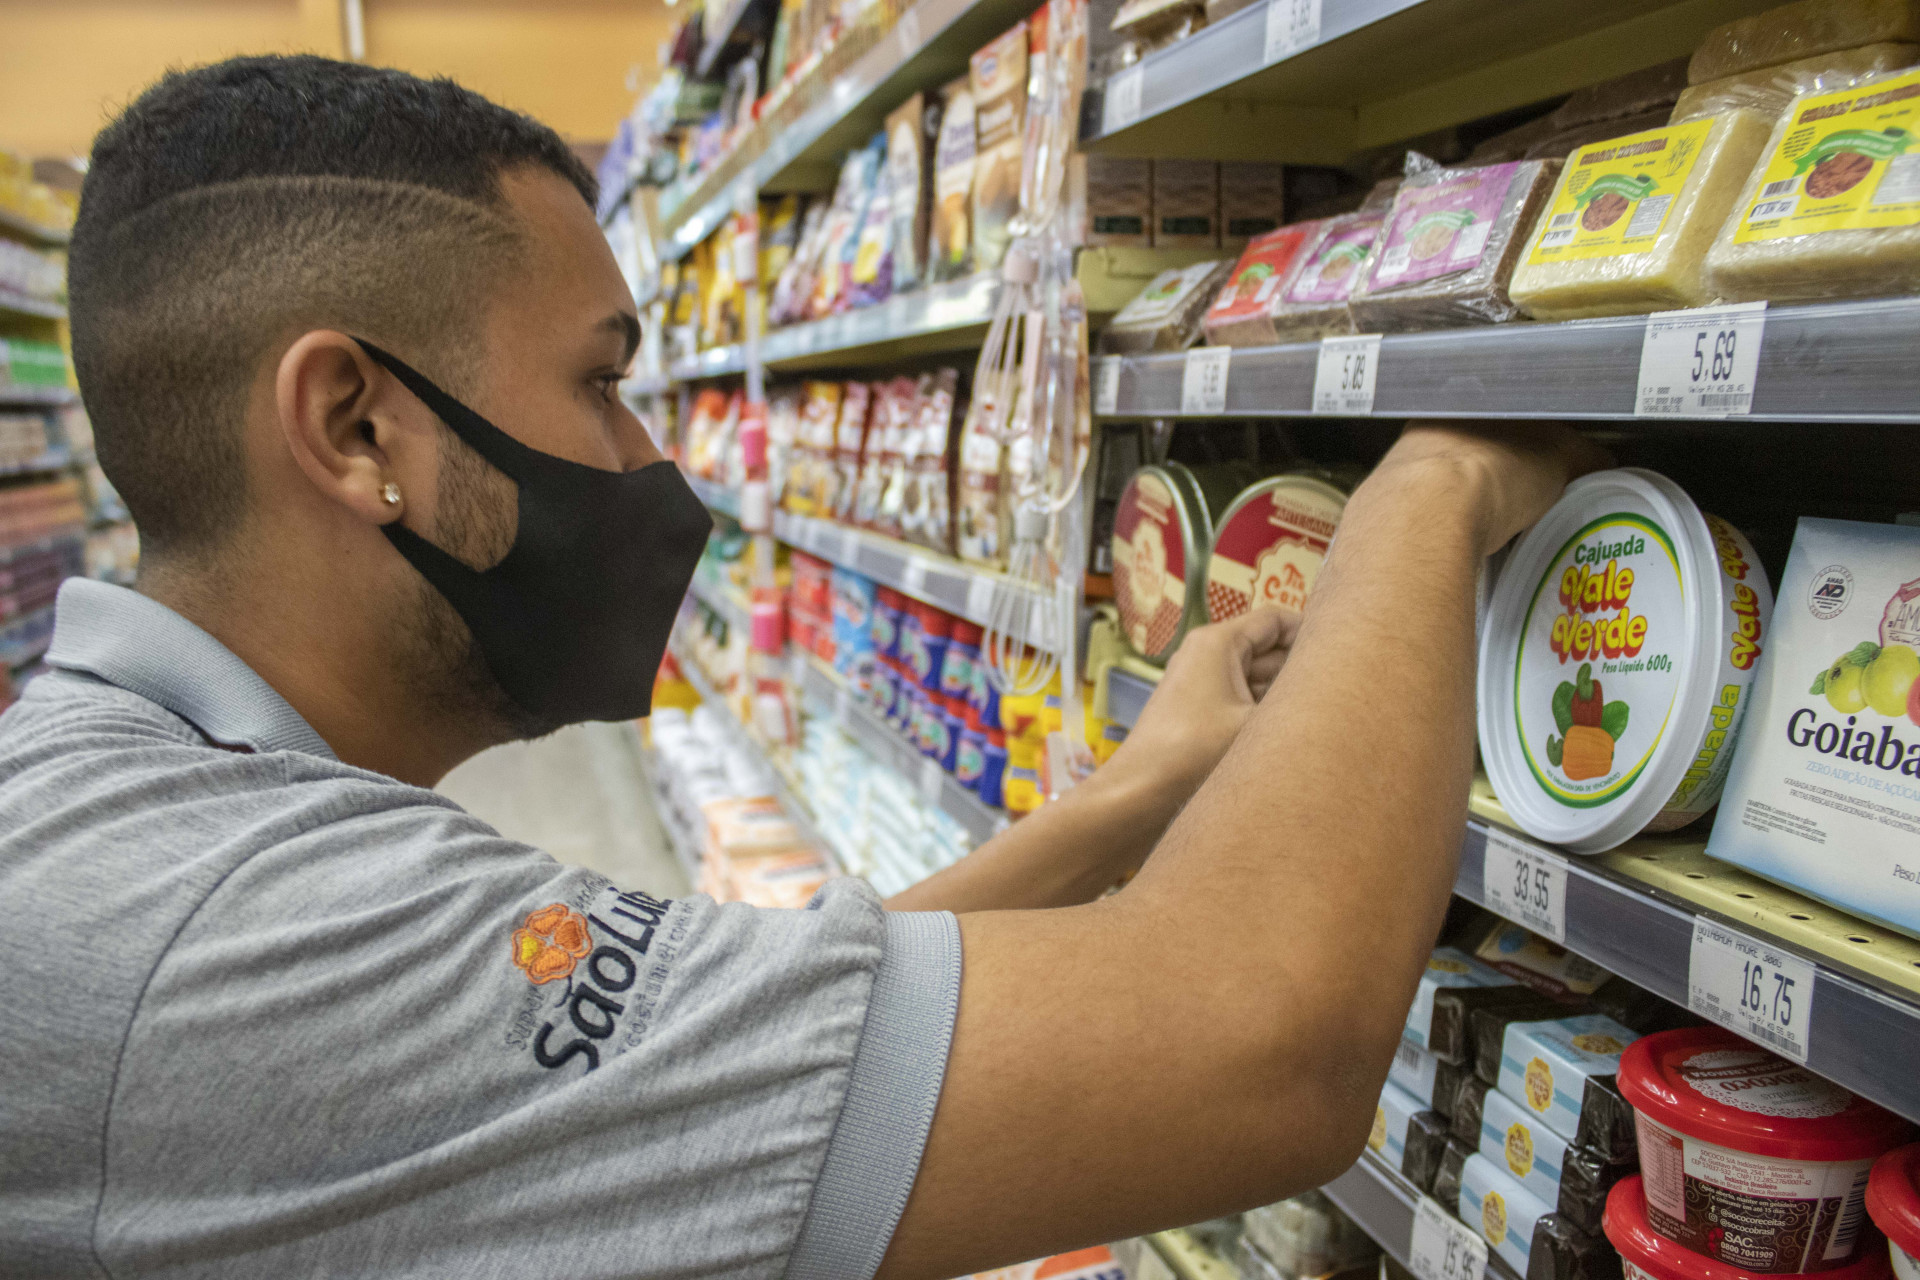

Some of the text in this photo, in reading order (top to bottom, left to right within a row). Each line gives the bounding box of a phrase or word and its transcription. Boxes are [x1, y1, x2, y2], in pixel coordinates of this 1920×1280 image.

[1692, 330, 1736, 382] 5,69
[1575, 534, 1645, 566] Cajuada
[1559, 559, 1635, 616] Vale
[1550, 606, 1648, 665] Verde
[1731, 583, 1763, 671] Vale
[1602, 654, 1673, 675] Peso Líquido 600g
[1787, 708, 1920, 779] Goiaba
[1806, 760, 1831, 777] ZERO
[1831, 767, 1868, 785] ADIÇÃO
[1868, 778, 1882, 791] DE
[1514, 859, 1550, 911] 33,55
[1741, 960, 1795, 1026] 16,75
[1700, 1149, 1725, 1162] SOCOCO
[1724, 1175, 1778, 1190] Indústria Brasileira
[1746, 1186, 1765, 1195] Marca
[1766, 1189, 1797, 1198] Registrada
[1736, 1195, 1758, 1205] manter
[1720, 1208, 1786, 1227] @sococoreceitas
[1720, 1218, 1775, 1236] @sococobrasil
[1720, 1241, 1774, 1259] 0800 7041909
[1724, 1231, 1753, 1249] SAC
